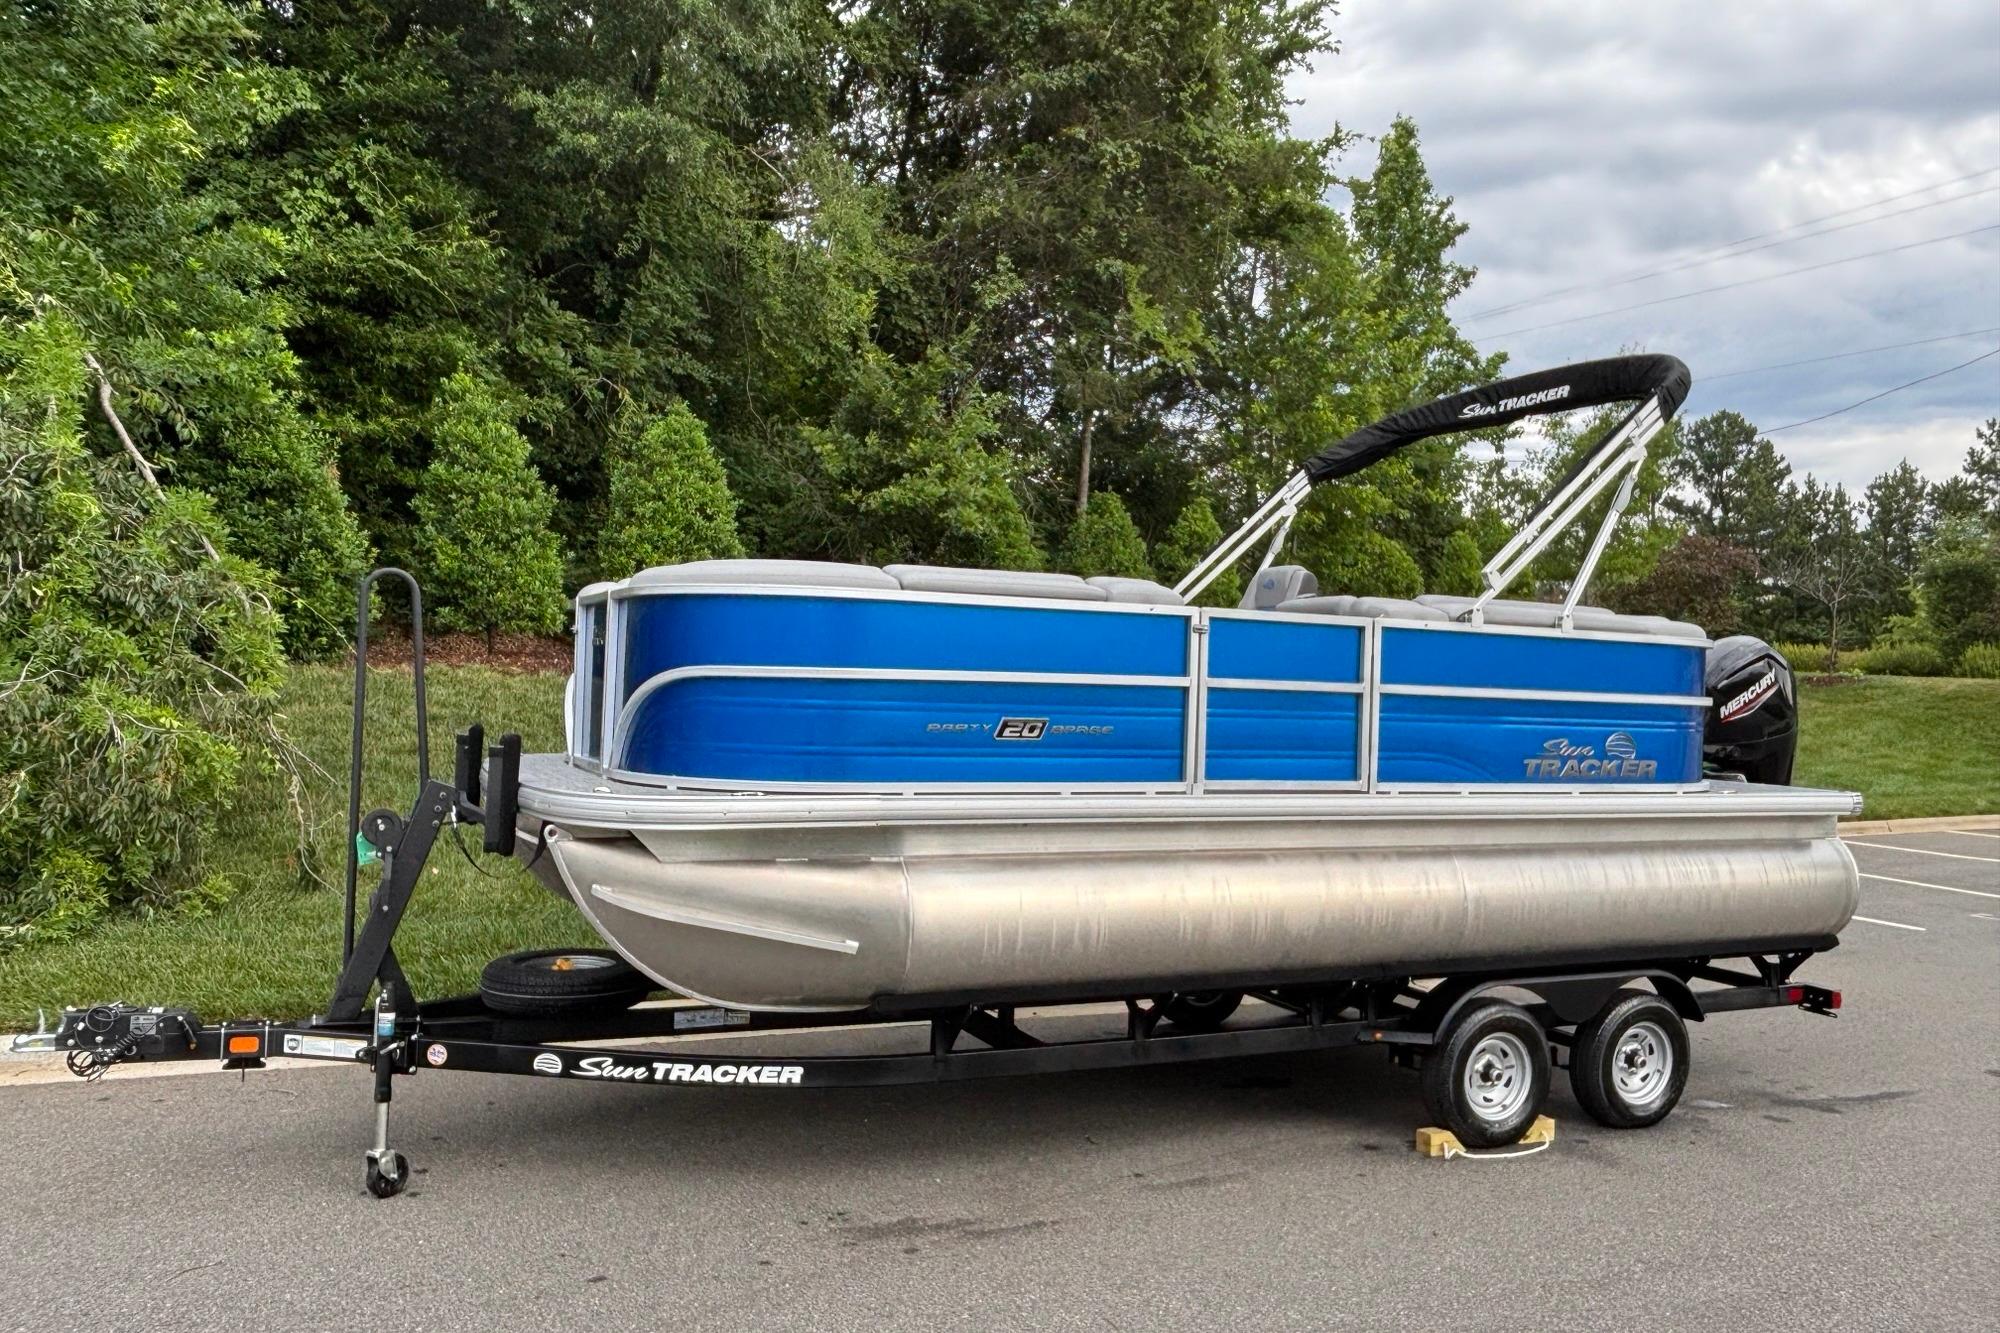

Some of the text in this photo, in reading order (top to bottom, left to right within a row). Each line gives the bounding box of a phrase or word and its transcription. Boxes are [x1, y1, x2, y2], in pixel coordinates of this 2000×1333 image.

[1498, 384, 1570, 412] TRACKER
[1719, 667, 1777, 719] MERCURY
[926, 722, 993, 734] PARTY
[1002, 721, 1044, 738] 20
[1523, 758, 1657, 777] TRACKER
[570, 1056, 804, 1084] Sun TRACKER
